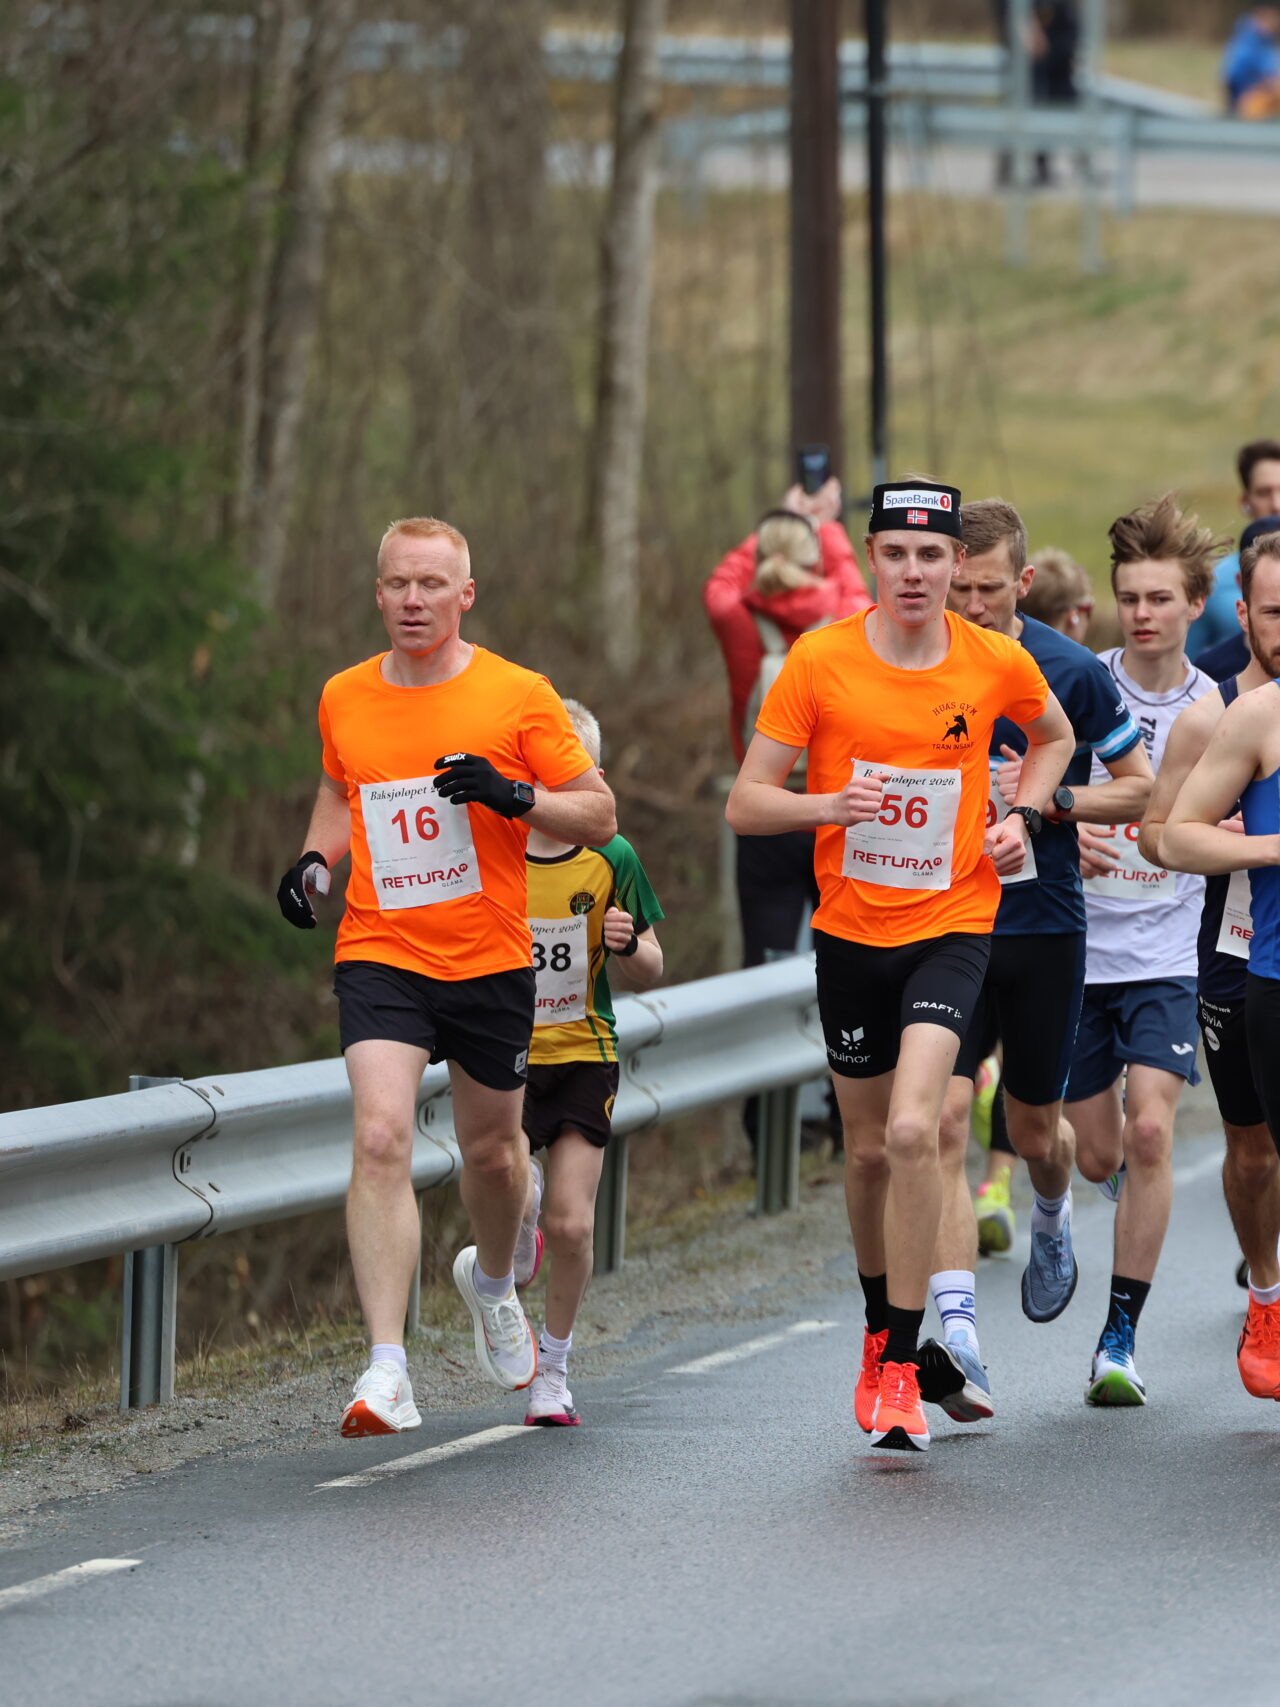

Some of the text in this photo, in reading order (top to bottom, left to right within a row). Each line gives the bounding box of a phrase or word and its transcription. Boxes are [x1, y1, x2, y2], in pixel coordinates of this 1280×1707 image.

[885, 494, 939, 507] SpareBank
[878, 793, 929, 829] 56
[391, 805, 440, 844] 16
[852, 849, 934, 870] RETURA
[381, 867, 460, 889] RETURA
[1102, 867, 1160, 882] TURA
[912, 1001, 955, 1014] CRAFT
